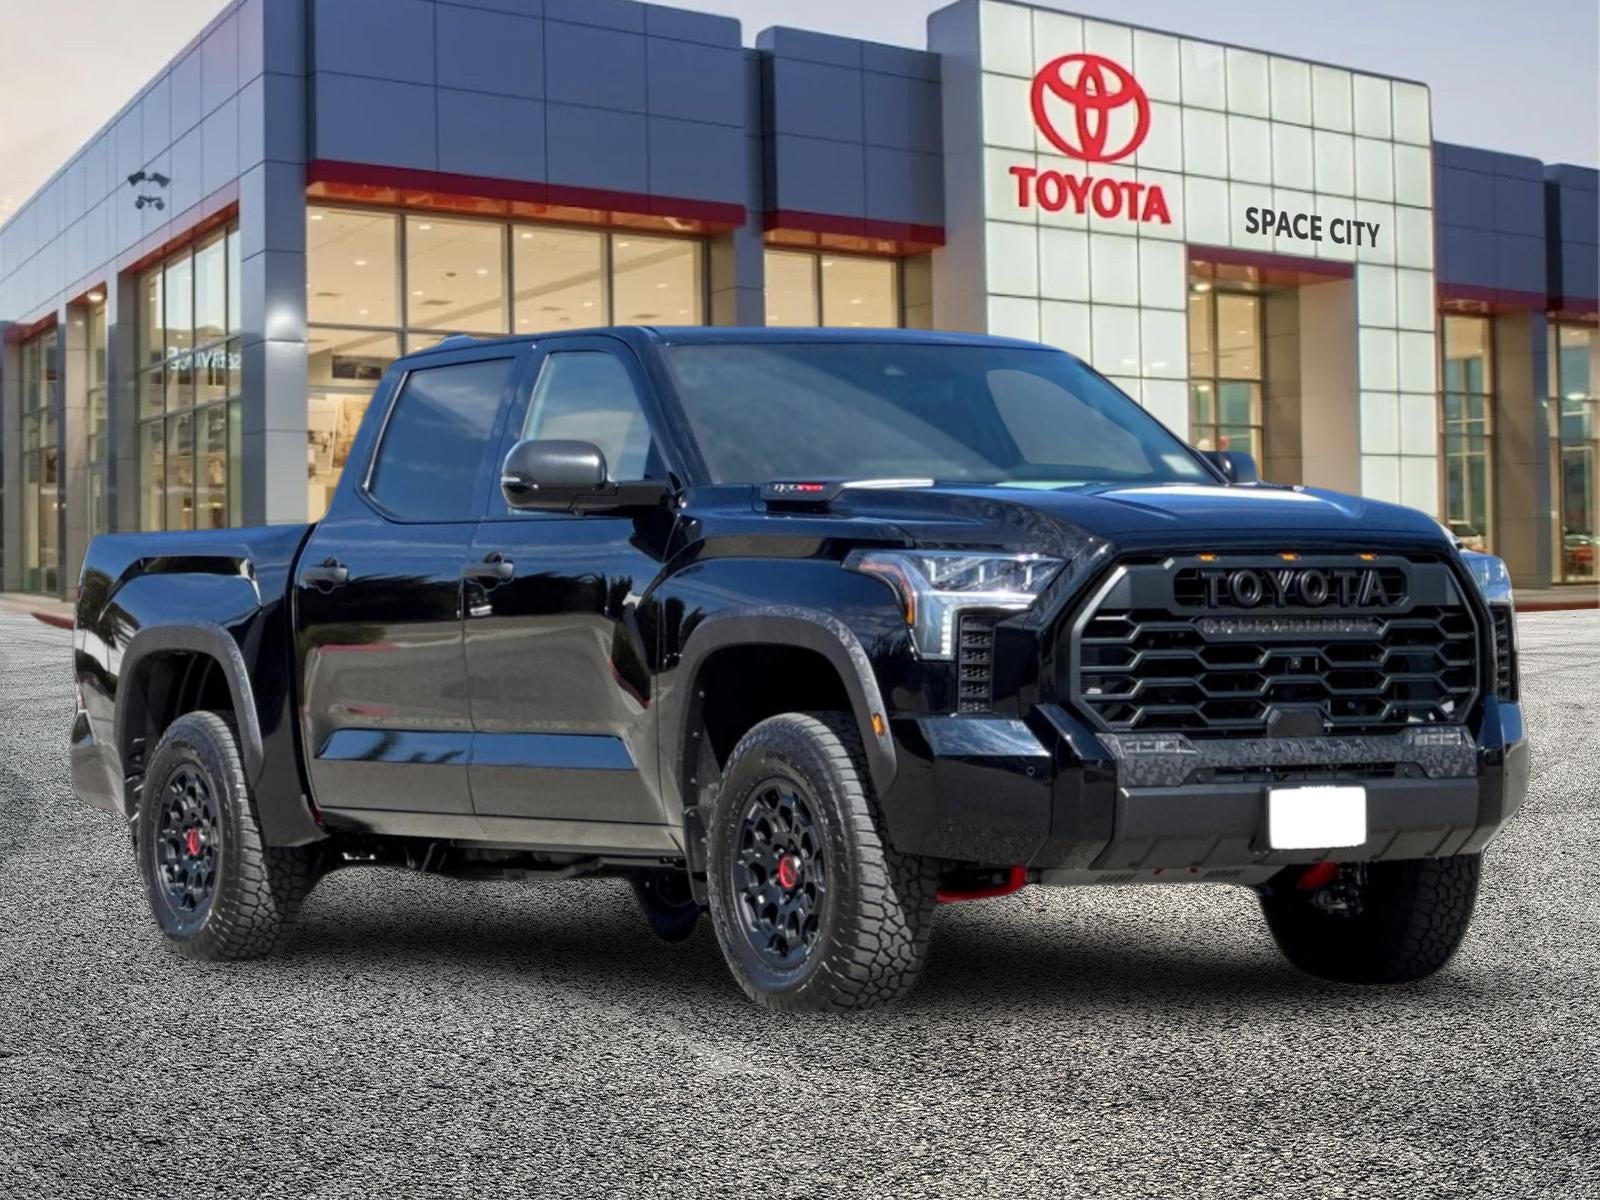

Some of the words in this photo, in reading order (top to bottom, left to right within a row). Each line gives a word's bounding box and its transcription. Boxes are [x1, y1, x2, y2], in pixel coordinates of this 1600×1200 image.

[1009, 166, 1171, 225] TOYOTA
[1245, 206, 1323, 242] SPACE
[1329, 217, 1381, 248] CITY
[1200, 568, 1391, 609] TOYOTA
